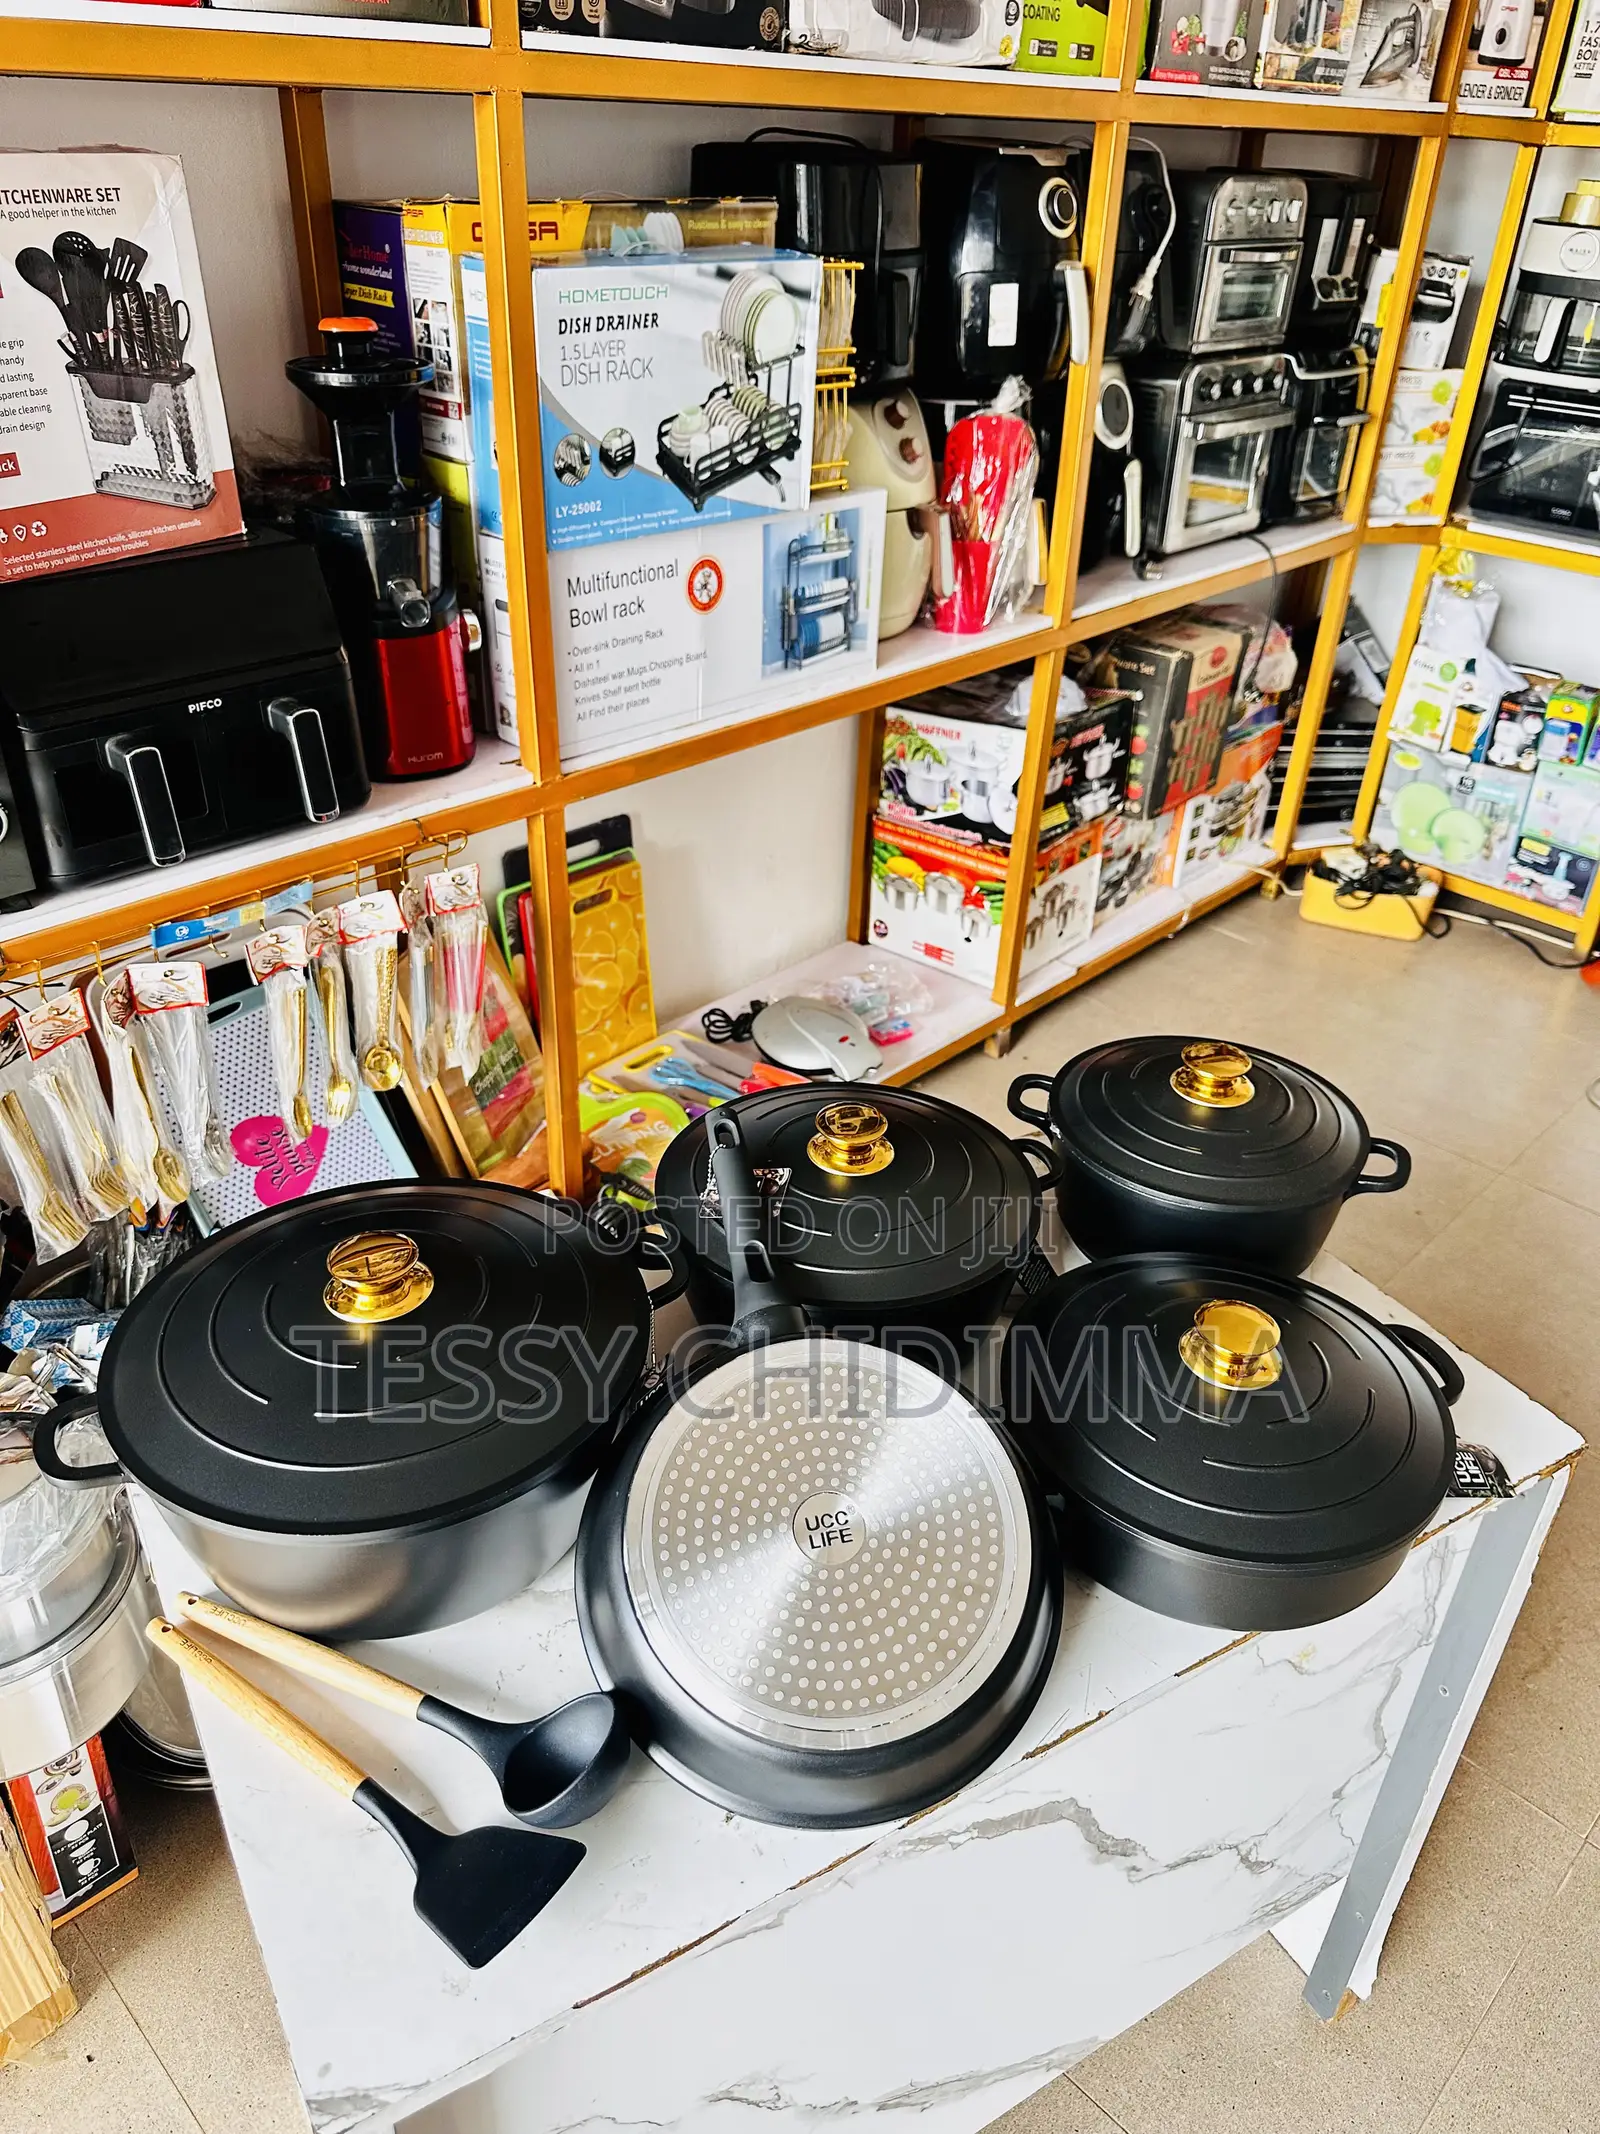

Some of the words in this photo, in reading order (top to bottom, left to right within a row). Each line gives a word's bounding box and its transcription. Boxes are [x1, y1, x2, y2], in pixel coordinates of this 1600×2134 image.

[1023, 4, 1060, 22] COATING
[1494, 86, 1524, 100] GRINDER
[96, 188, 121, 202] SET
[8, 209, 30, 221] good
[32, 208, 59, 219] helper
[60, 208, 69, 217] in
[71, 207, 85, 216] the
[86, 206, 116, 216] kitchen
[559, 284, 669, 305] HOMETOUCH
[559, 314, 591, 336] DISH
[596, 313, 659, 333] DRAINER
[8, 339, 24, 350] grip
[561, 343, 581, 361] 1.5
[582, 339, 627, 359] LAYER
[6, 371, 34, 383] lasting
[561, 361, 601, 388] DISH
[606, 357, 654, 382] RACK
[30, 387, 48, 398] base
[18, 403, 52, 416] cleaning
[19, 421, 45, 432] design
[555, 500, 602, 518] LY-25002
[4, 552, 36, 566] Selected
[36, 546, 67, 559] stainless
[67, 542, 83, 553] steel
[83, 537, 108, 550] kitchen
[128, 528, 153, 540] silicone
[153, 523, 177, 536] kitchen
[12, 565, 25, 575] set
[25, 563, 33, 572] to
[33, 559, 50, 572] help
[50, 557, 64, 569] you
[64, 554, 80, 565] with
[80, 551, 96, 563] your
[96, 545, 122, 558] kitchen
[122, 540, 149, 553] troubles
[567, 559, 679, 599] Multifunctional
[570, 603, 608, 628] Bowl
[613, 596, 646, 620] rack
[572, 640, 610, 658] Over-sink
[612, 632, 644, 649] Draining
[645, 628, 664, 641] Rack
[574, 662, 585, 674] All
[587, 661, 594, 671] in
[1139, 661, 1156, 676] Set
[188, 698, 223, 713] PIFCO
[575, 693, 601, 706] Knives
[602, 686, 622, 700] Shelf
[576, 711, 588, 723] All
[589, 706, 606, 719] Find
[607, 701, 625, 714] their
[626, 696, 650, 710] places
[475, 1068, 503, 1096] Chopping
[1464, 1452, 1485, 1483] LIFE
[805, 1511, 849, 1531] UCC
[809, 1528, 853, 1549] LIFE
[87, 1822, 103, 1836] PLATE
